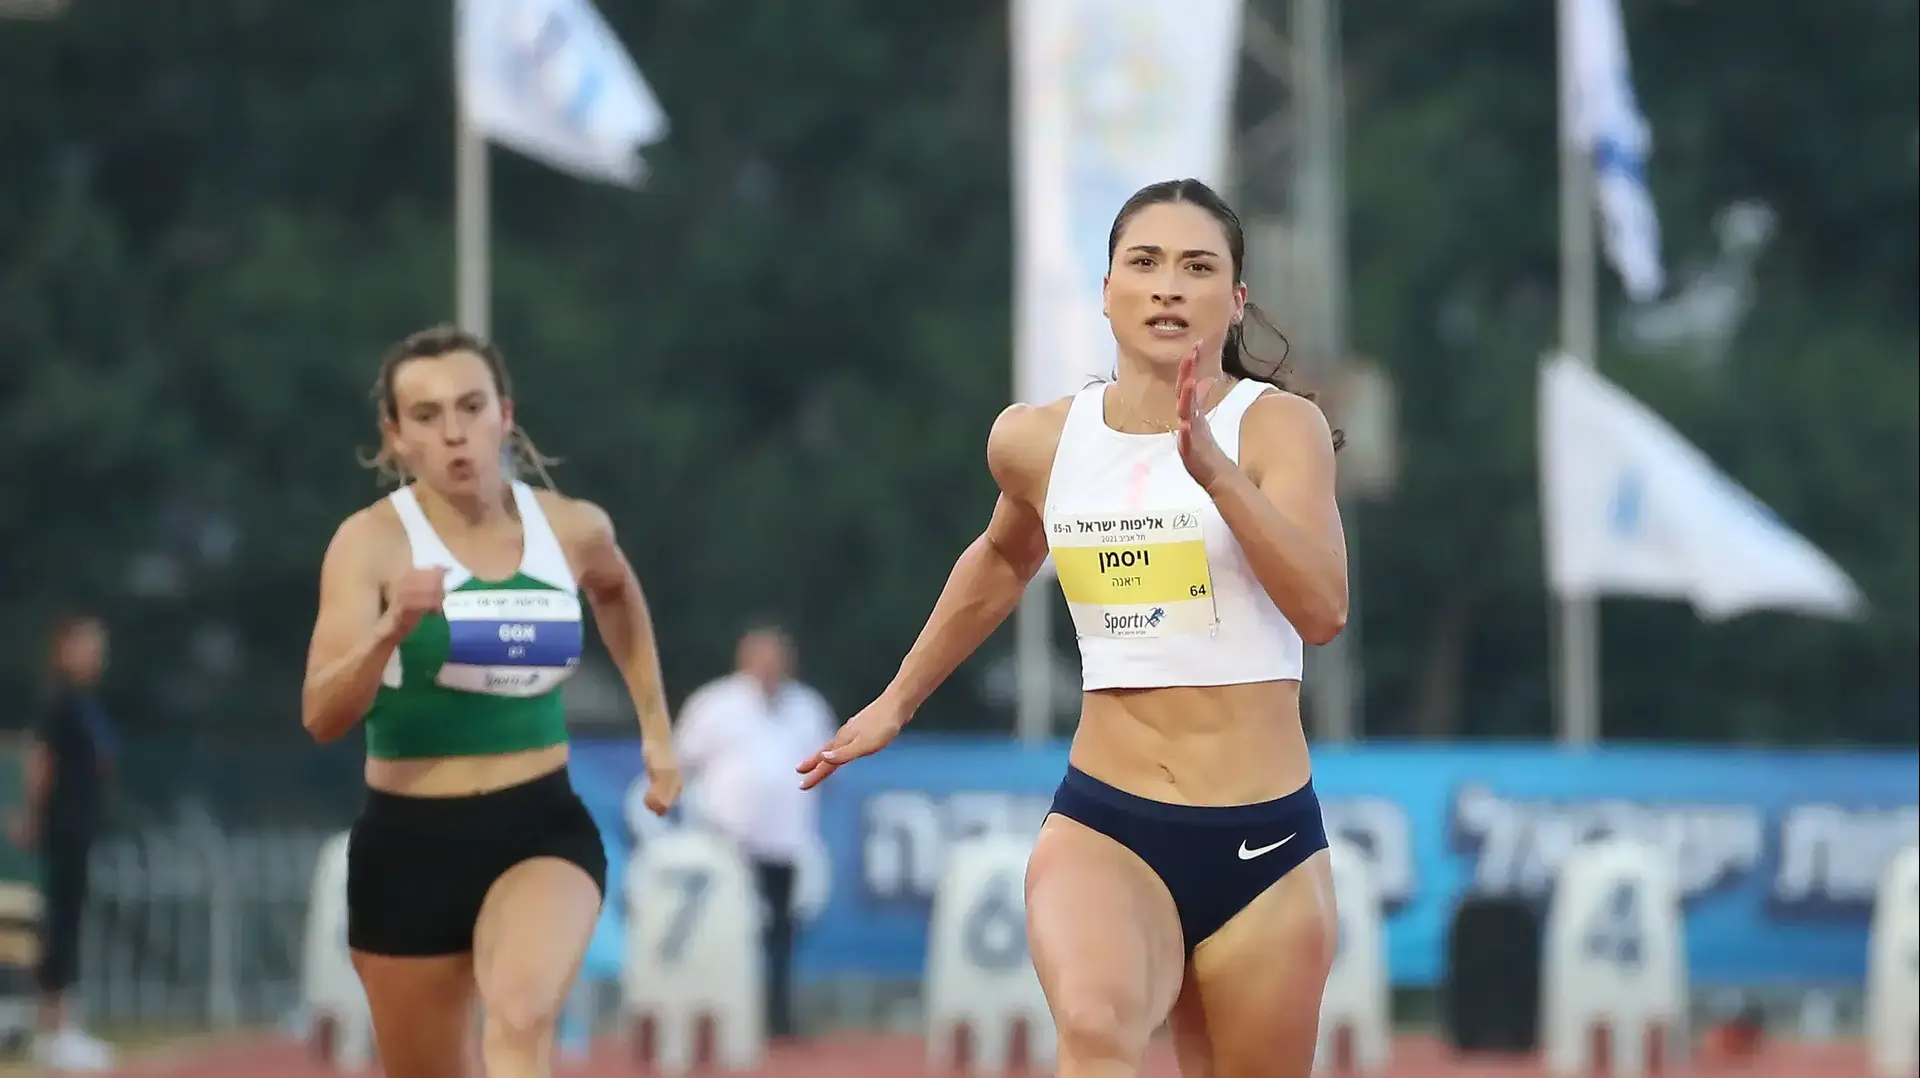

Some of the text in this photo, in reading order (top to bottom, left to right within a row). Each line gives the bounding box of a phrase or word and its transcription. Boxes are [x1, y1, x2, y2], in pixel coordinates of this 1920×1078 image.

[1053, 516, 1164, 534] אליפות ישראל ה-85
[1101, 533, 1146, 543] תל אביב 2021
[1098, 550, 1150, 574] ויסמן
[1112, 576, 1142, 587] דיאנה
[1189, 584, 1207, 597] 64
[656, 865, 713, 963] 7
[963, 872, 1029, 973] 6
[1582, 876, 1648, 963] 4
